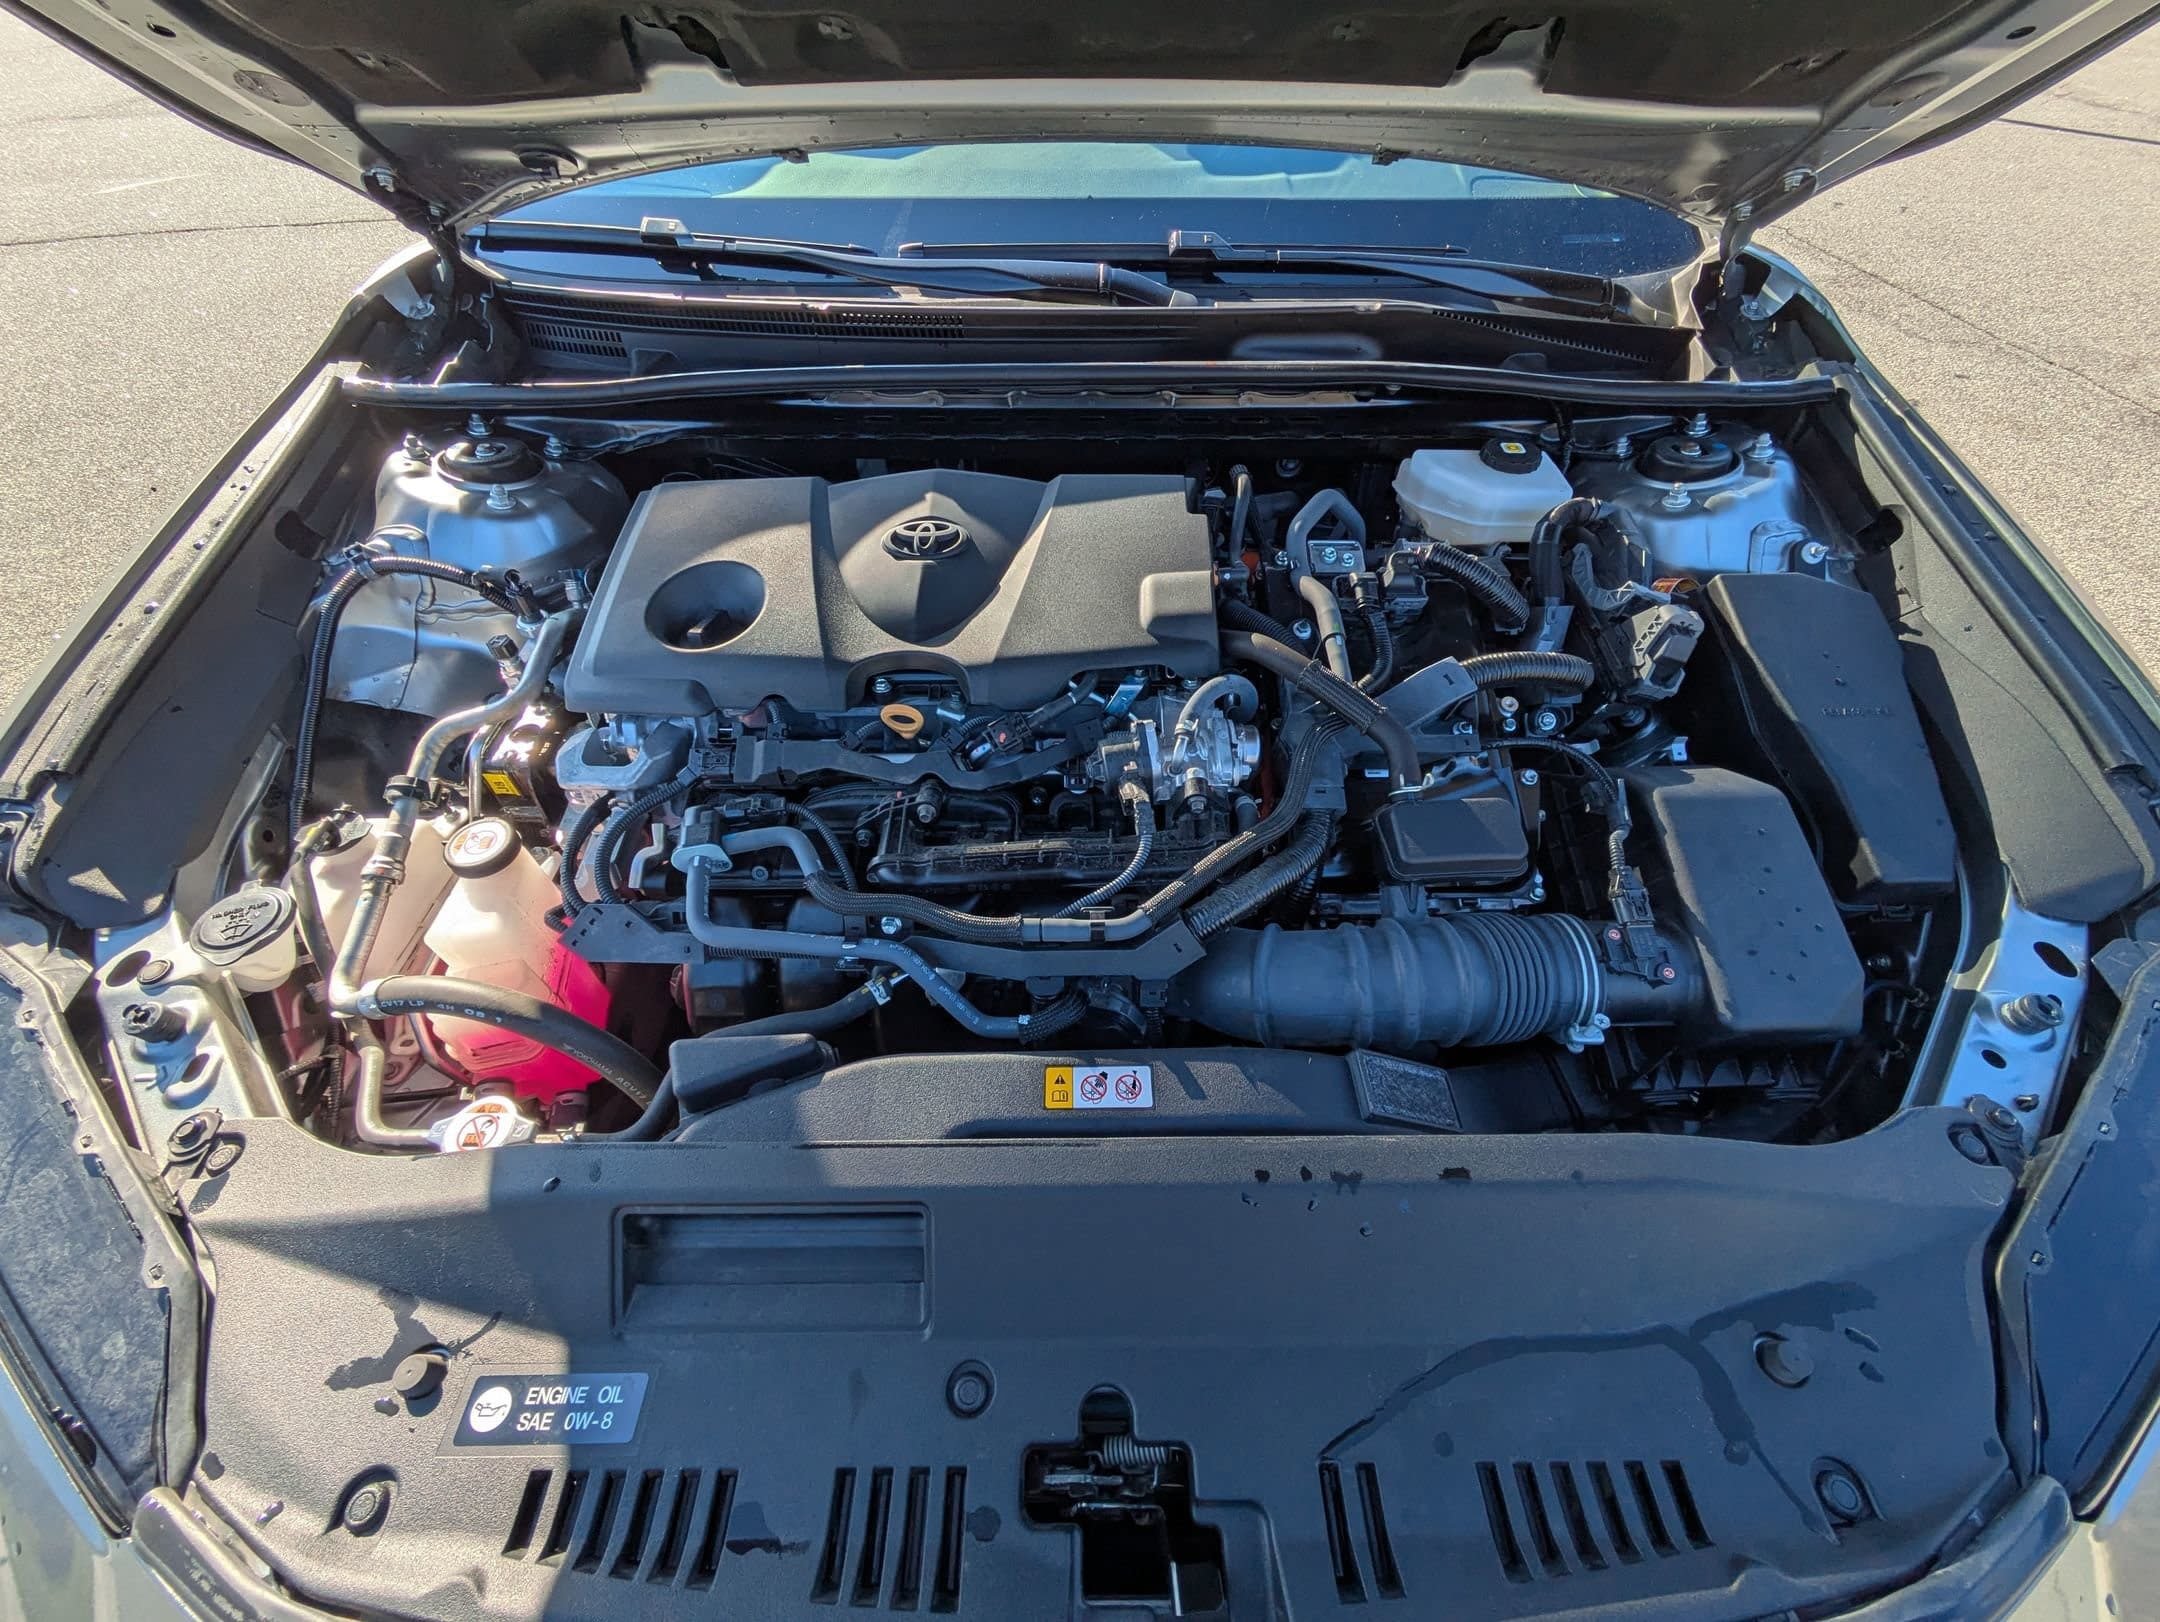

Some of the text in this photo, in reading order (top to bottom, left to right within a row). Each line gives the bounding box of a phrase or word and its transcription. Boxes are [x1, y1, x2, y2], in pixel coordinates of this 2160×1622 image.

[524, 1385, 624, 1405] ENGINE OIL
[516, 1411, 614, 1432] SAE 0W-8
